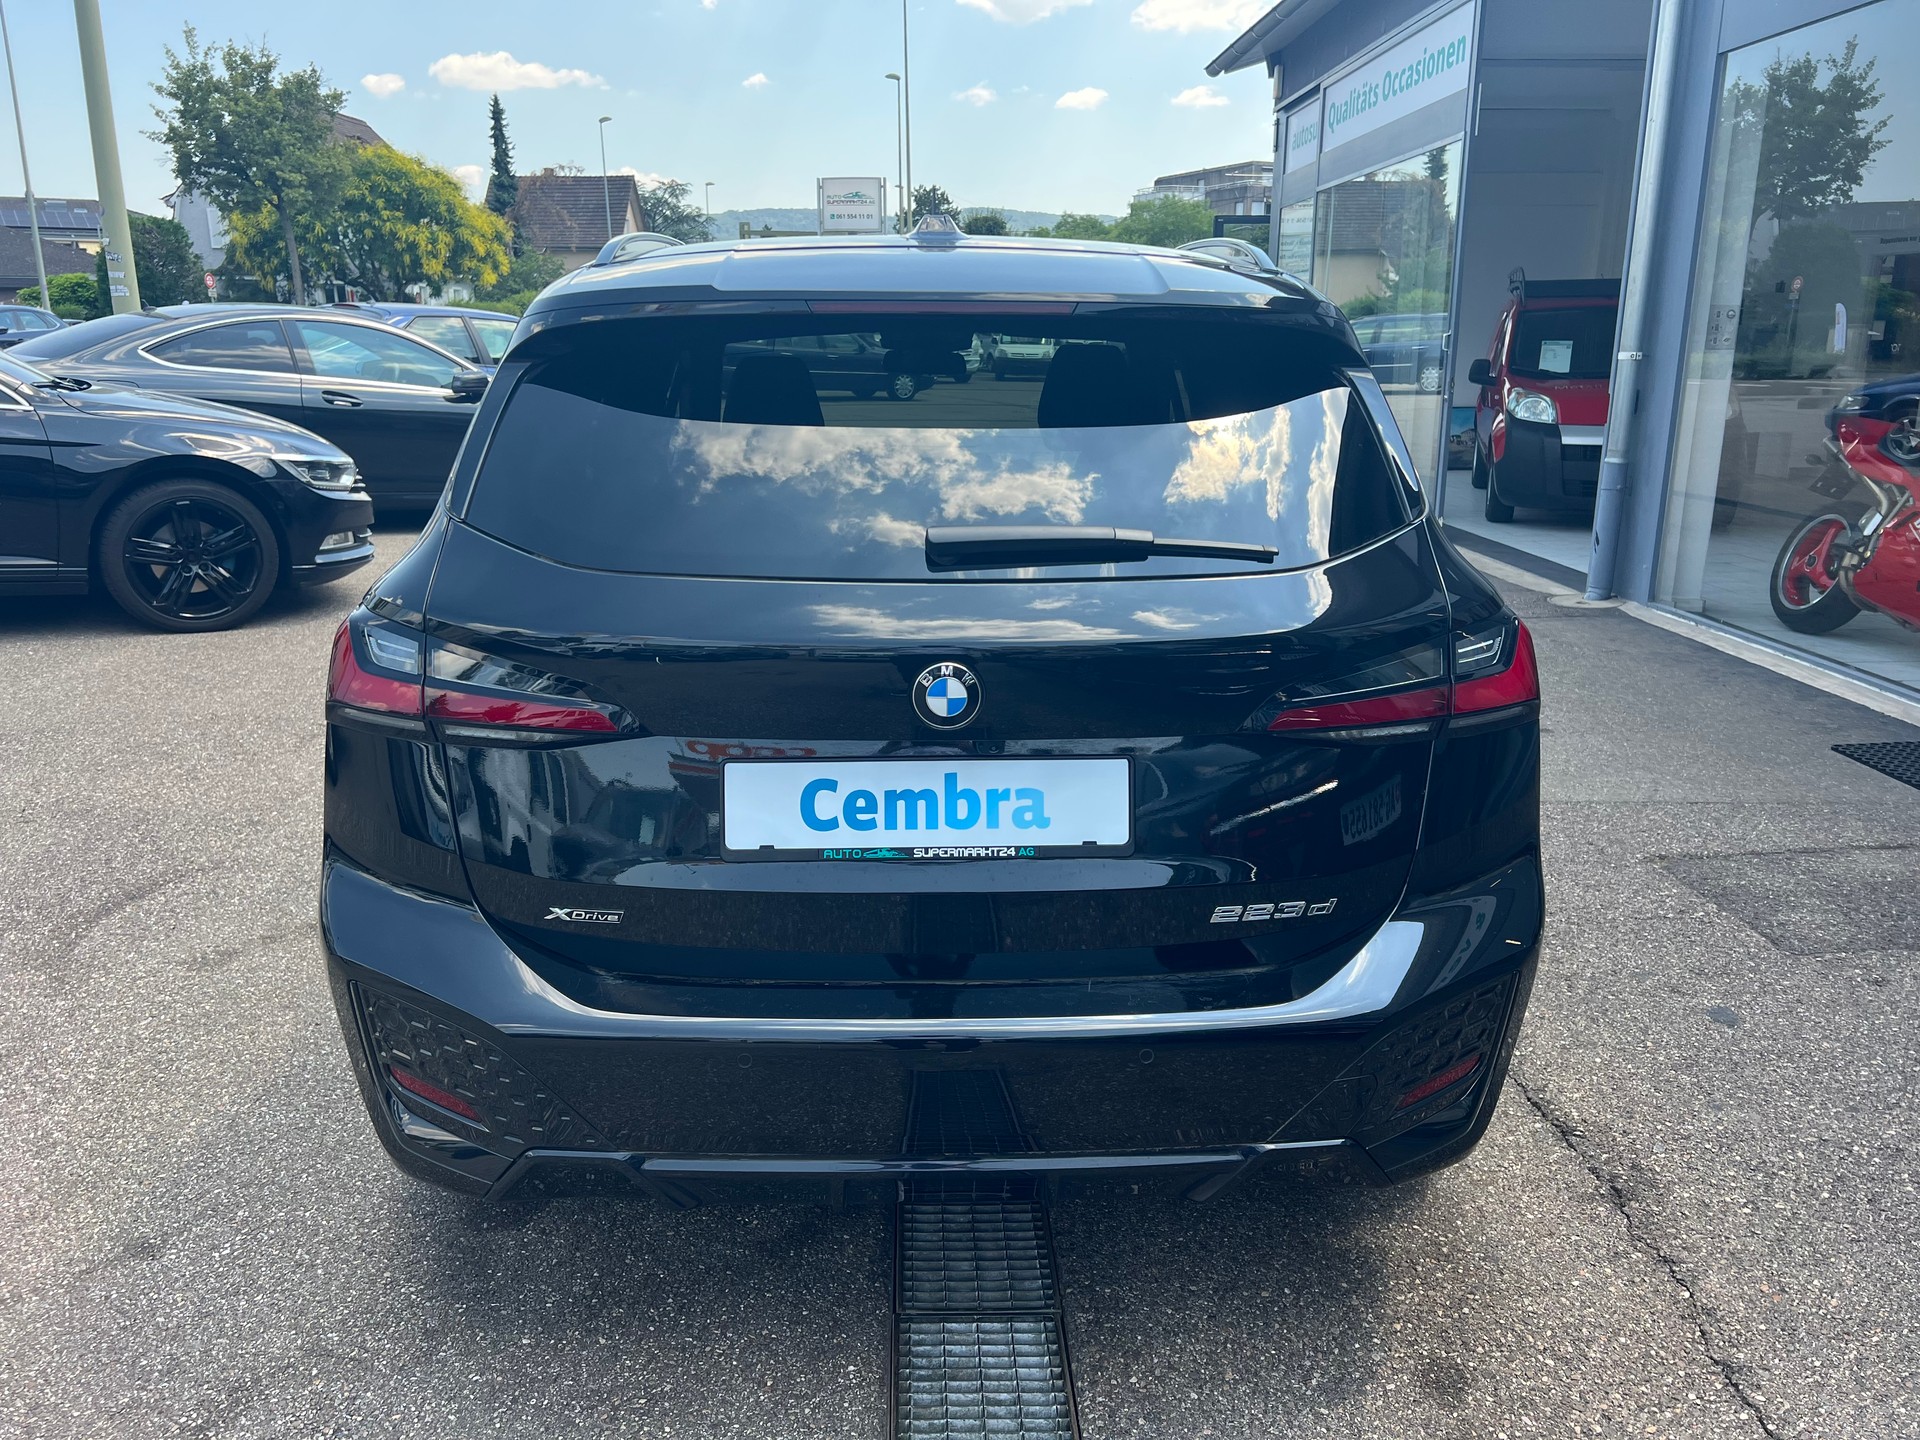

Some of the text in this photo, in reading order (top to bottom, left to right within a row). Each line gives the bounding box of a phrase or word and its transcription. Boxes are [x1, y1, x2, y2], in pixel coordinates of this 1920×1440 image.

[1328, 34, 1467, 134] Qualitäts Occasionen
[919, 665, 975, 688] BMW
[799, 772, 1051, 833] Cembra
[823, 847, 1035, 859] AUTO SUPERMARKT24 AG
[1210, 898, 1338, 924] 223d
